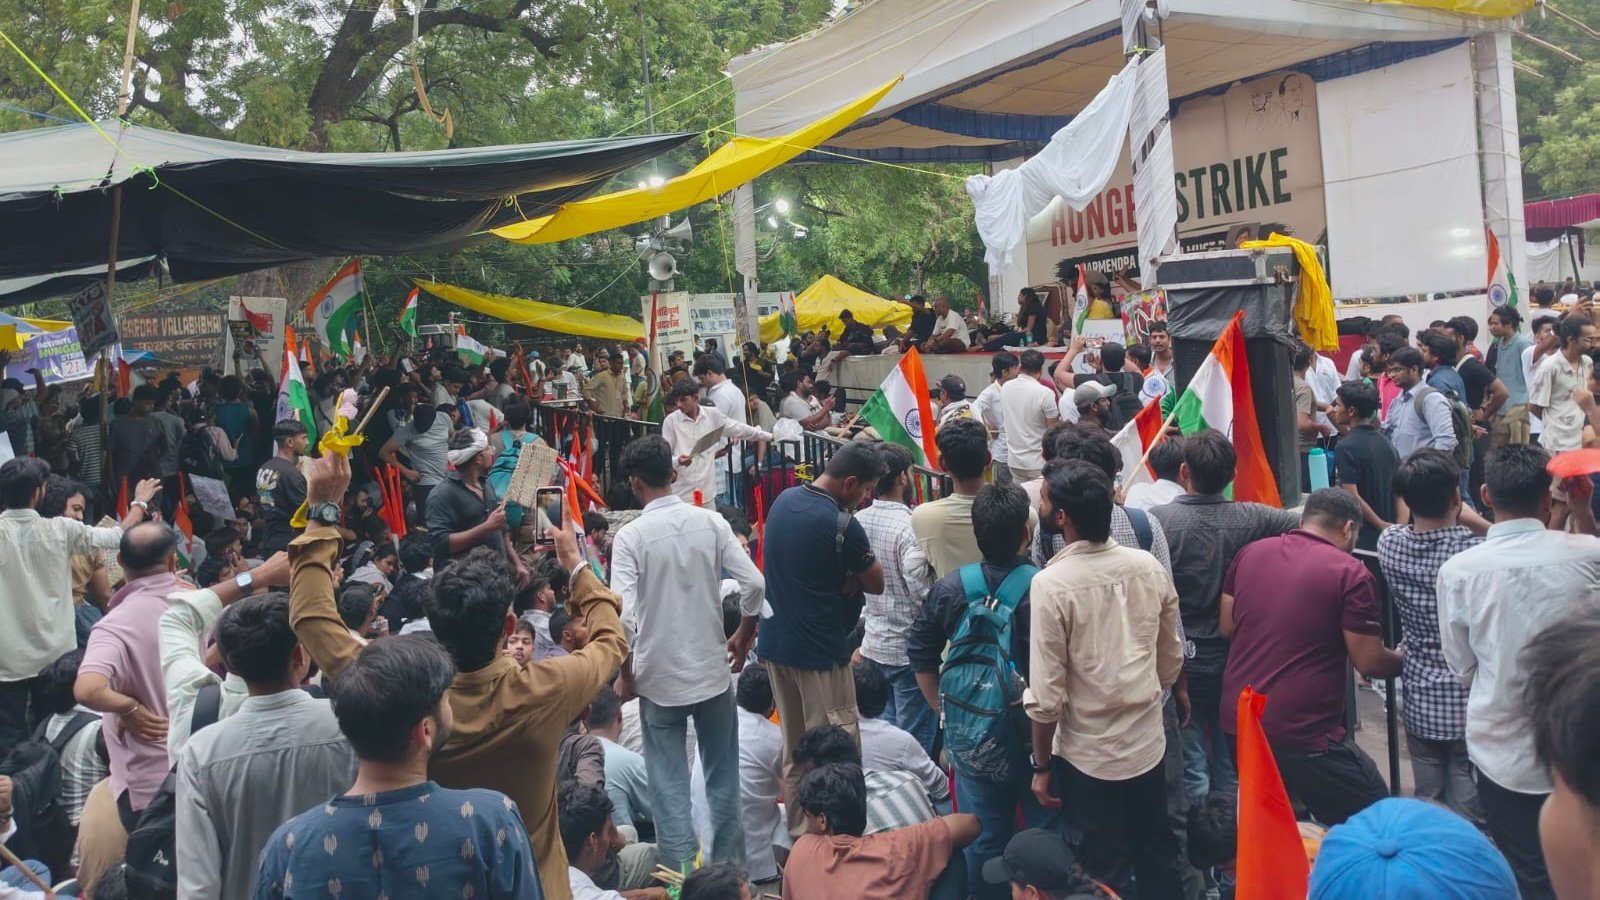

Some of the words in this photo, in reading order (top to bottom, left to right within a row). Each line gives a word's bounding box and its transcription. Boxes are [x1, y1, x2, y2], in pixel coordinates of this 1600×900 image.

[1051, 184, 1137, 247] HUNGE
[1174, 146, 1292, 223] STRIKE
[1074, 254, 1137, 273] ARMENDRA
[121, 318, 159, 338] SARDAR
[60, 350, 84, 362] STRIK
[66, 360, 79, 374] 21
